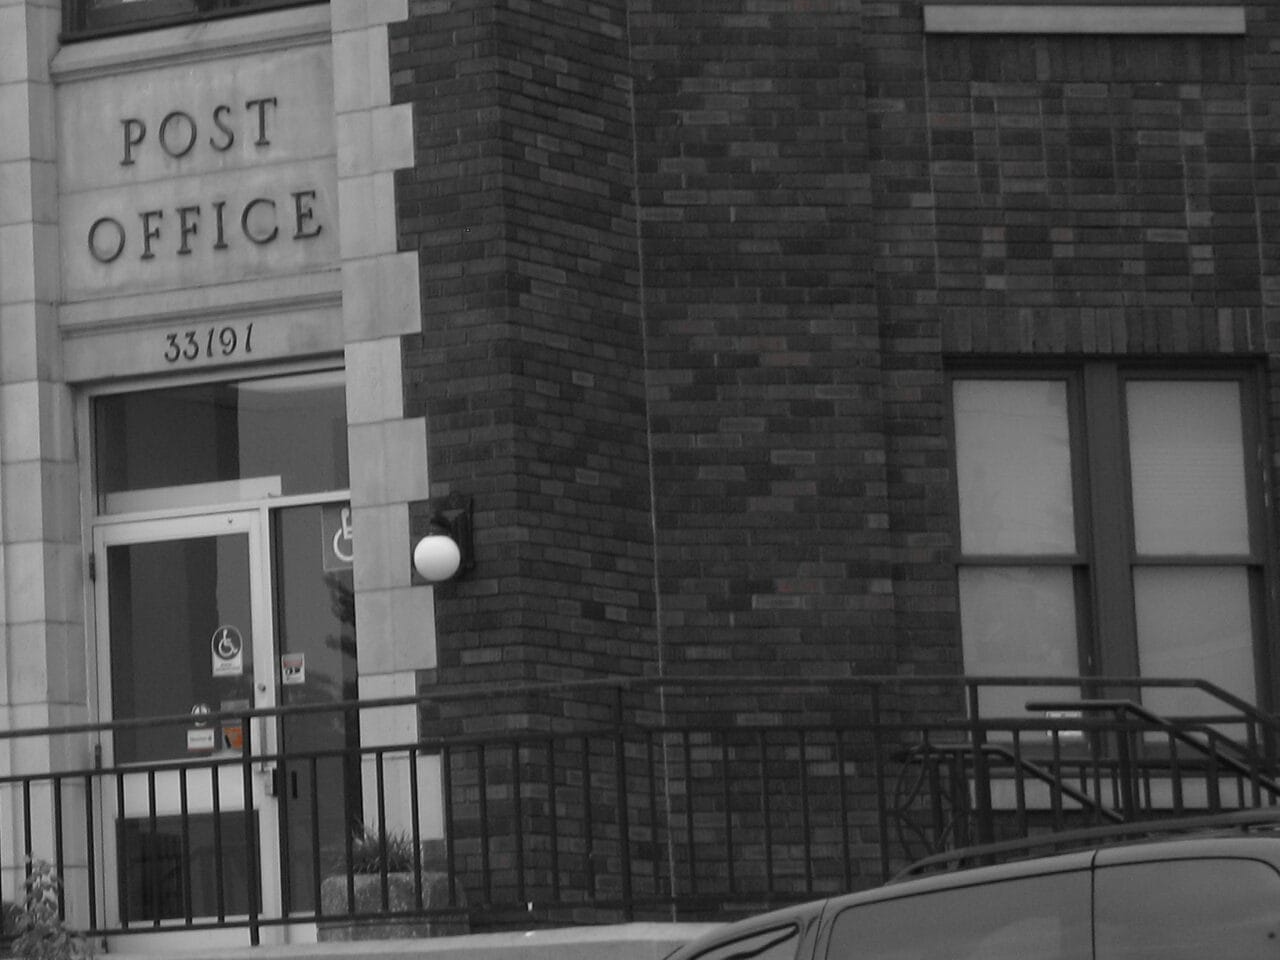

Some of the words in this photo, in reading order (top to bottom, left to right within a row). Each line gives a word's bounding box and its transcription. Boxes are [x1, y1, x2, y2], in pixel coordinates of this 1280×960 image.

[119, 96, 278, 167] POST
[87, 190, 324, 264] OFFICE
[164, 322, 255, 363] 33191
